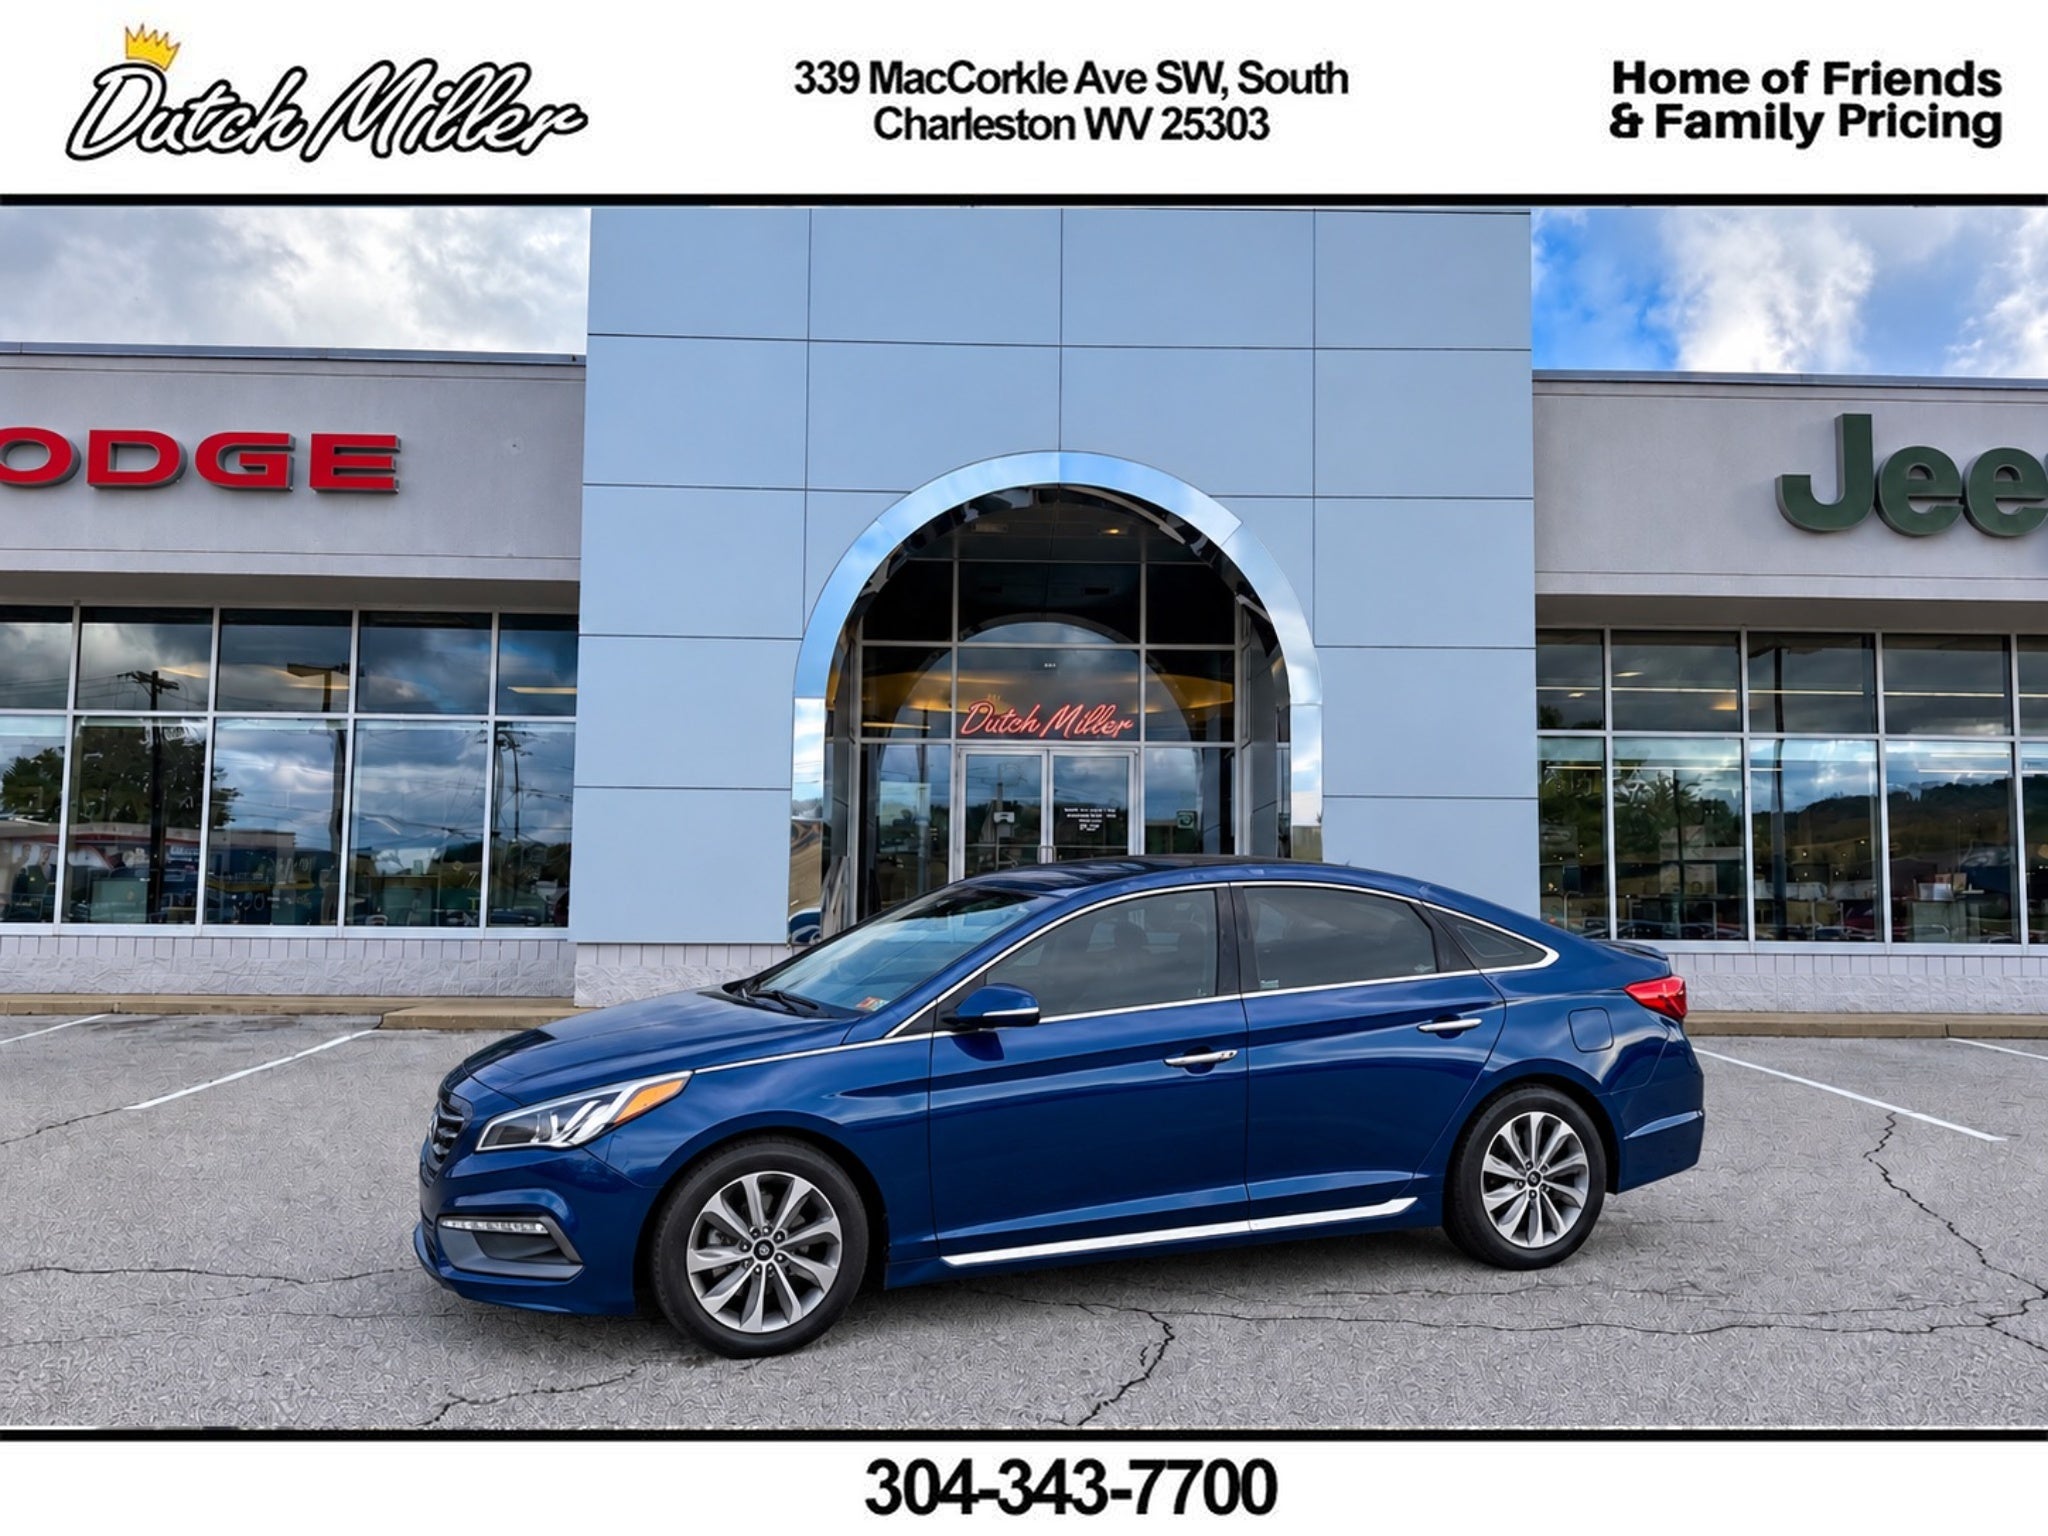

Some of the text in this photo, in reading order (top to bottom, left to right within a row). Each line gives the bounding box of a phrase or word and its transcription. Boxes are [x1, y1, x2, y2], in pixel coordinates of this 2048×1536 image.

[1774, 413, 2048, 538] Jee
[960, 700, 1134, 739] Dutch Miller
